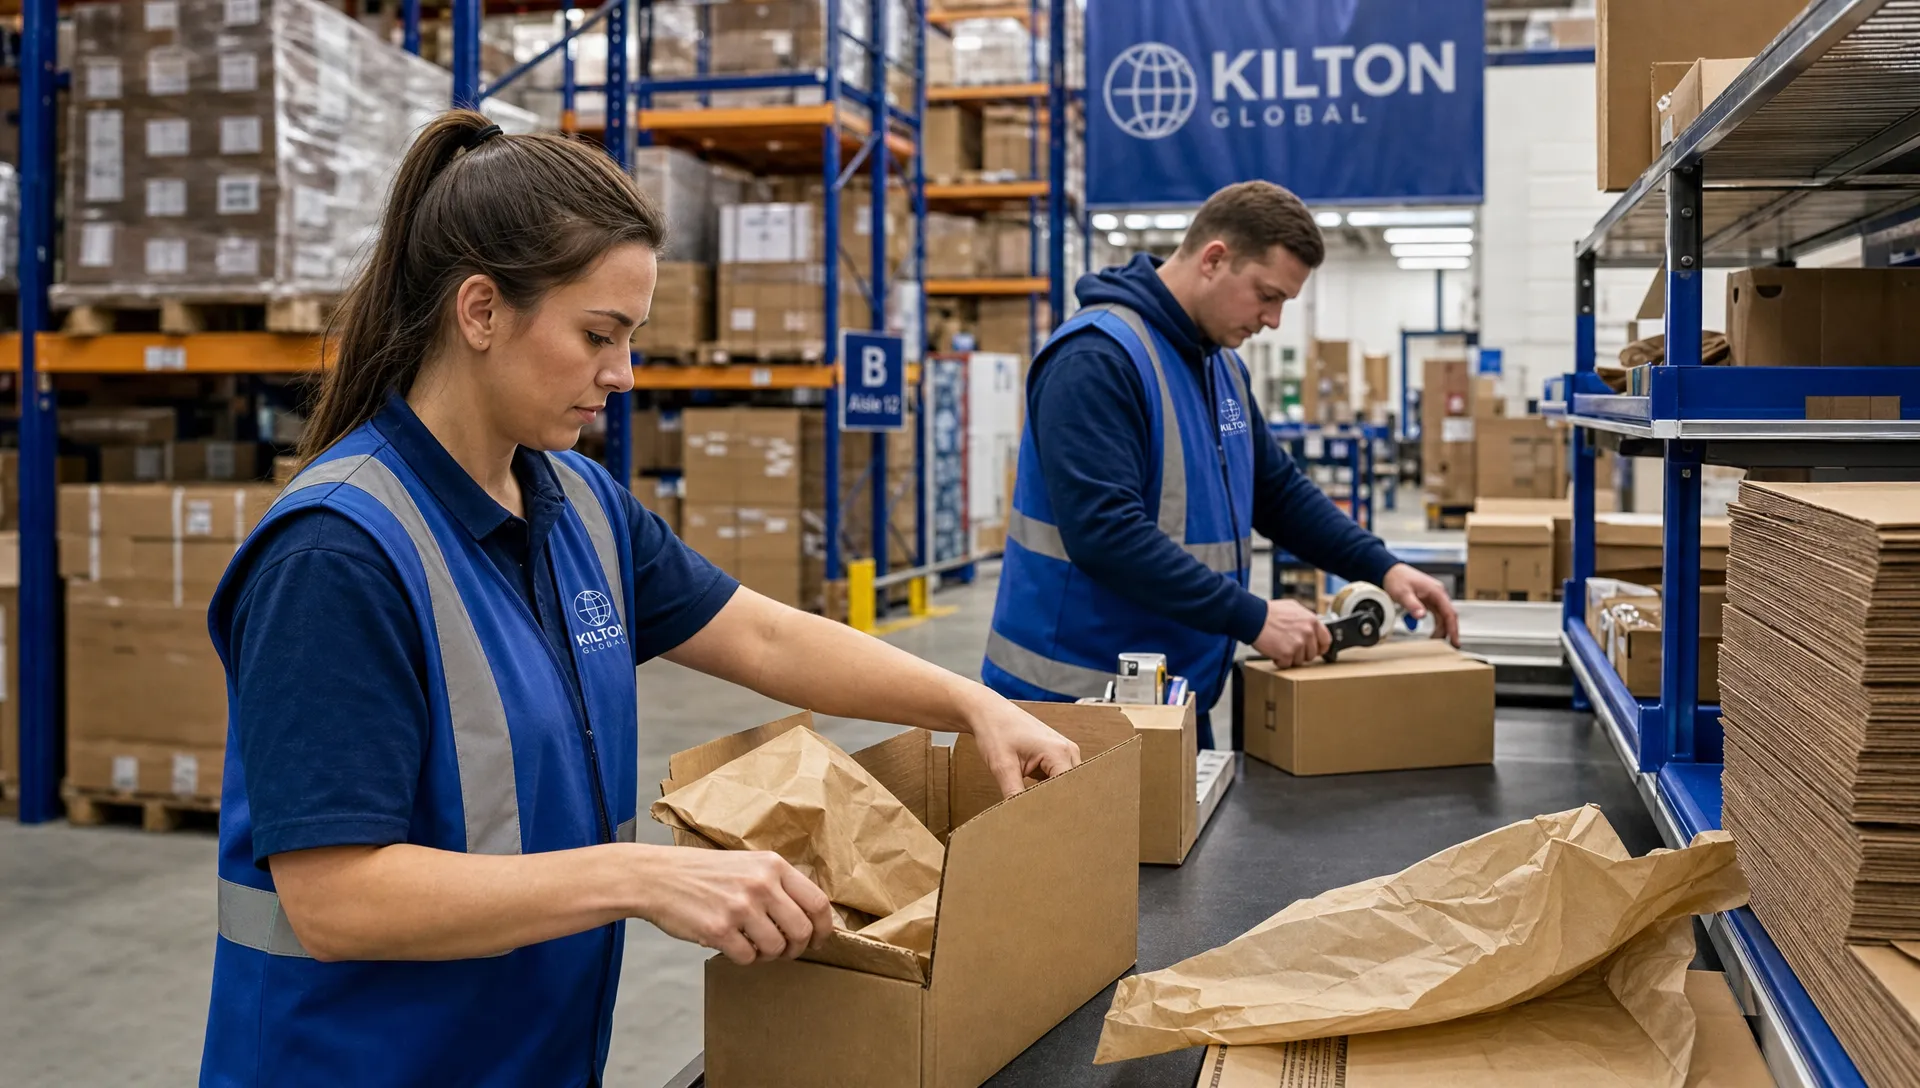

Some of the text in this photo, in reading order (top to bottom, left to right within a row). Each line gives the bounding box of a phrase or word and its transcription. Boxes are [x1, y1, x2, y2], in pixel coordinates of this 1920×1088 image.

[1212, 41, 1455, 101] KILTON
[1210, 103, 1367, 128] GLOBAL
[862, 345, 888, 388] B
